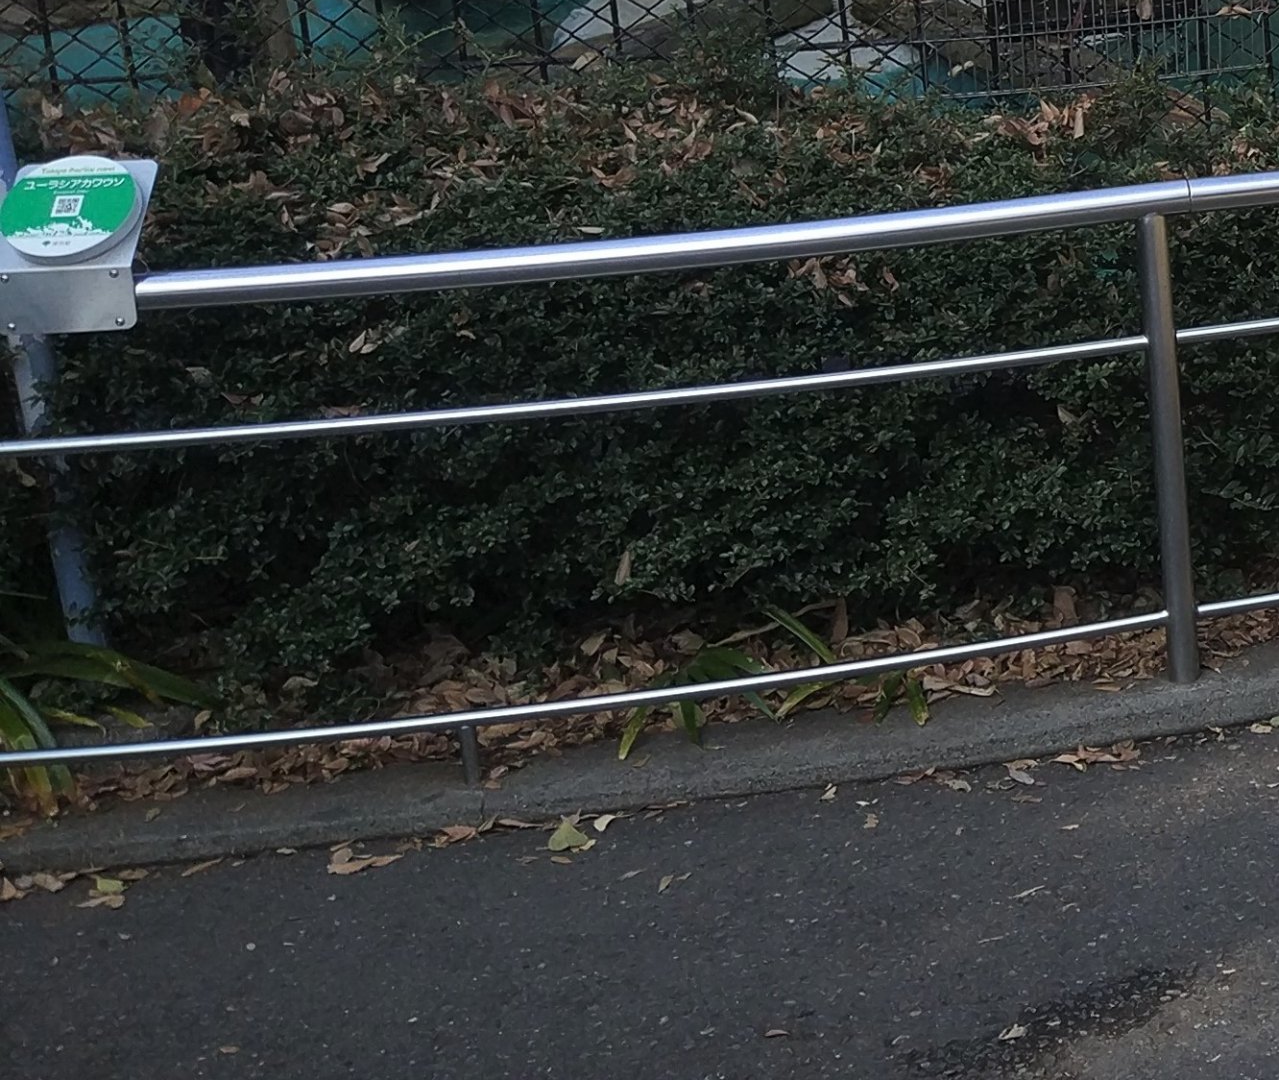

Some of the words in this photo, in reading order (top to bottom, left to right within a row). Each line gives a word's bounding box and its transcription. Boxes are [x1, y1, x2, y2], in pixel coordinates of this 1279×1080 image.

[24, 177, 125, 191] ユーラシアカワウソ
